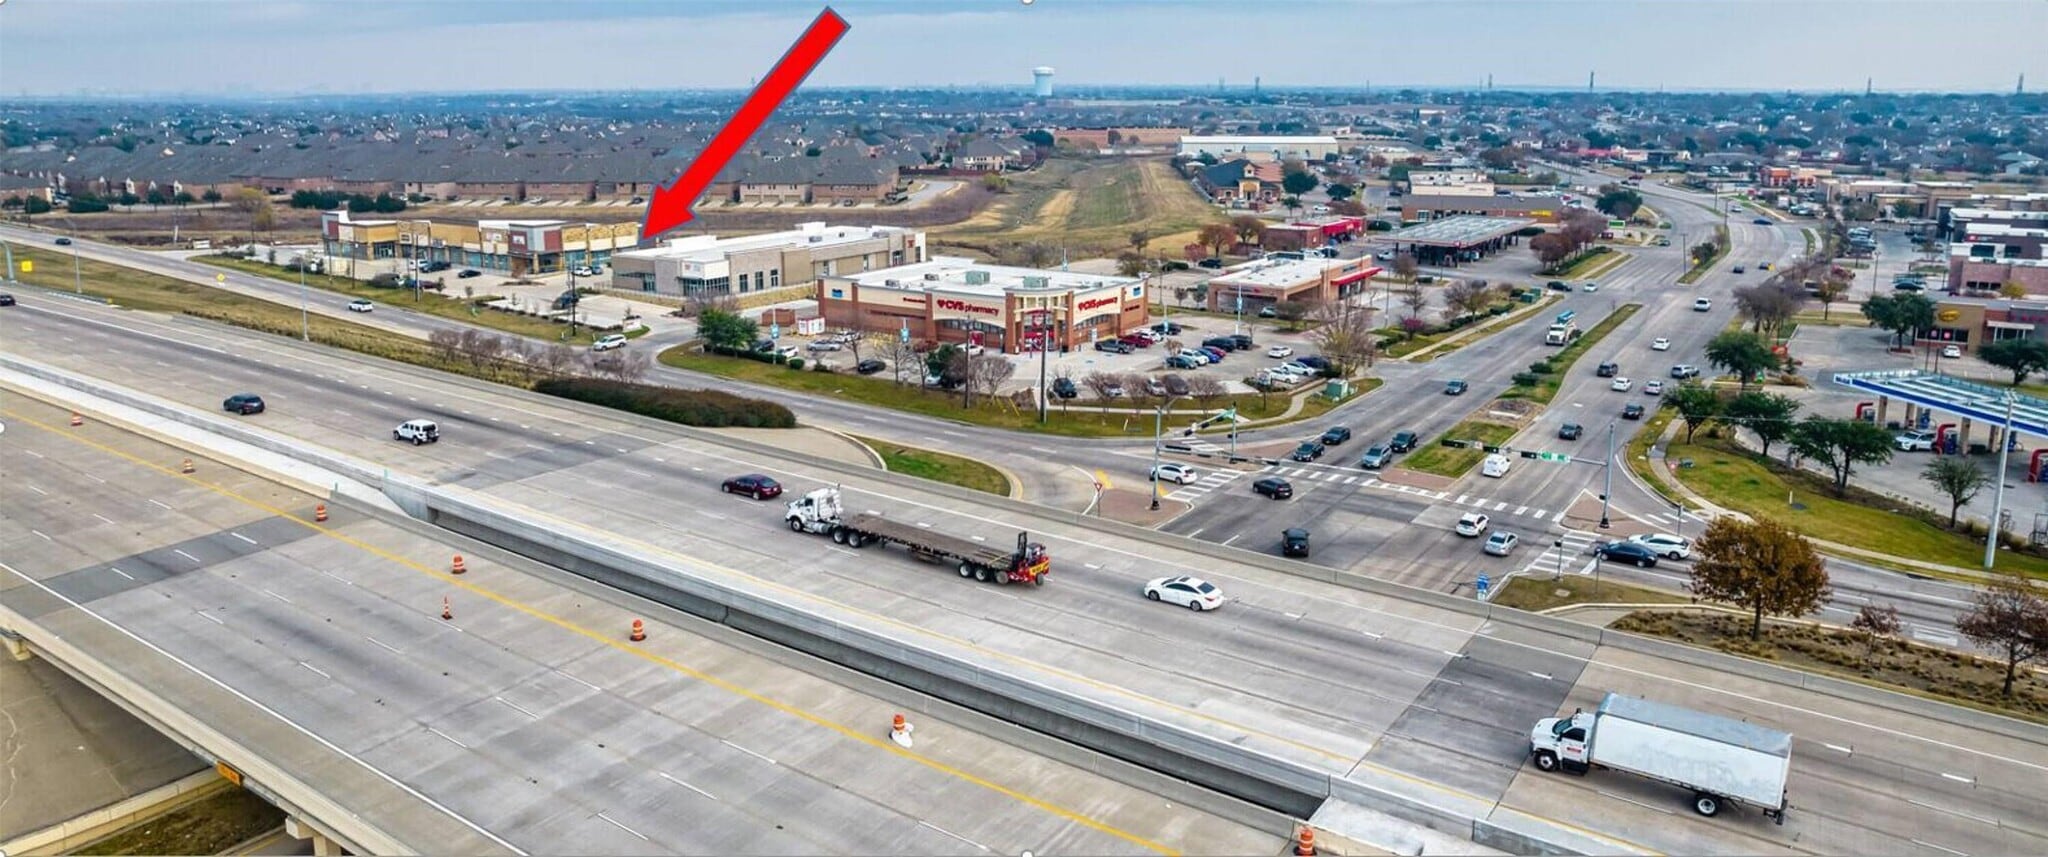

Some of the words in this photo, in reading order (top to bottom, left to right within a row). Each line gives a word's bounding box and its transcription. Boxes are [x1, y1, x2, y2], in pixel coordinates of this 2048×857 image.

[945, 300, 964, 311] CVS
[965, 303, 1000, 316] pharmacy
[1084, 299, 1096, 310] CVS
